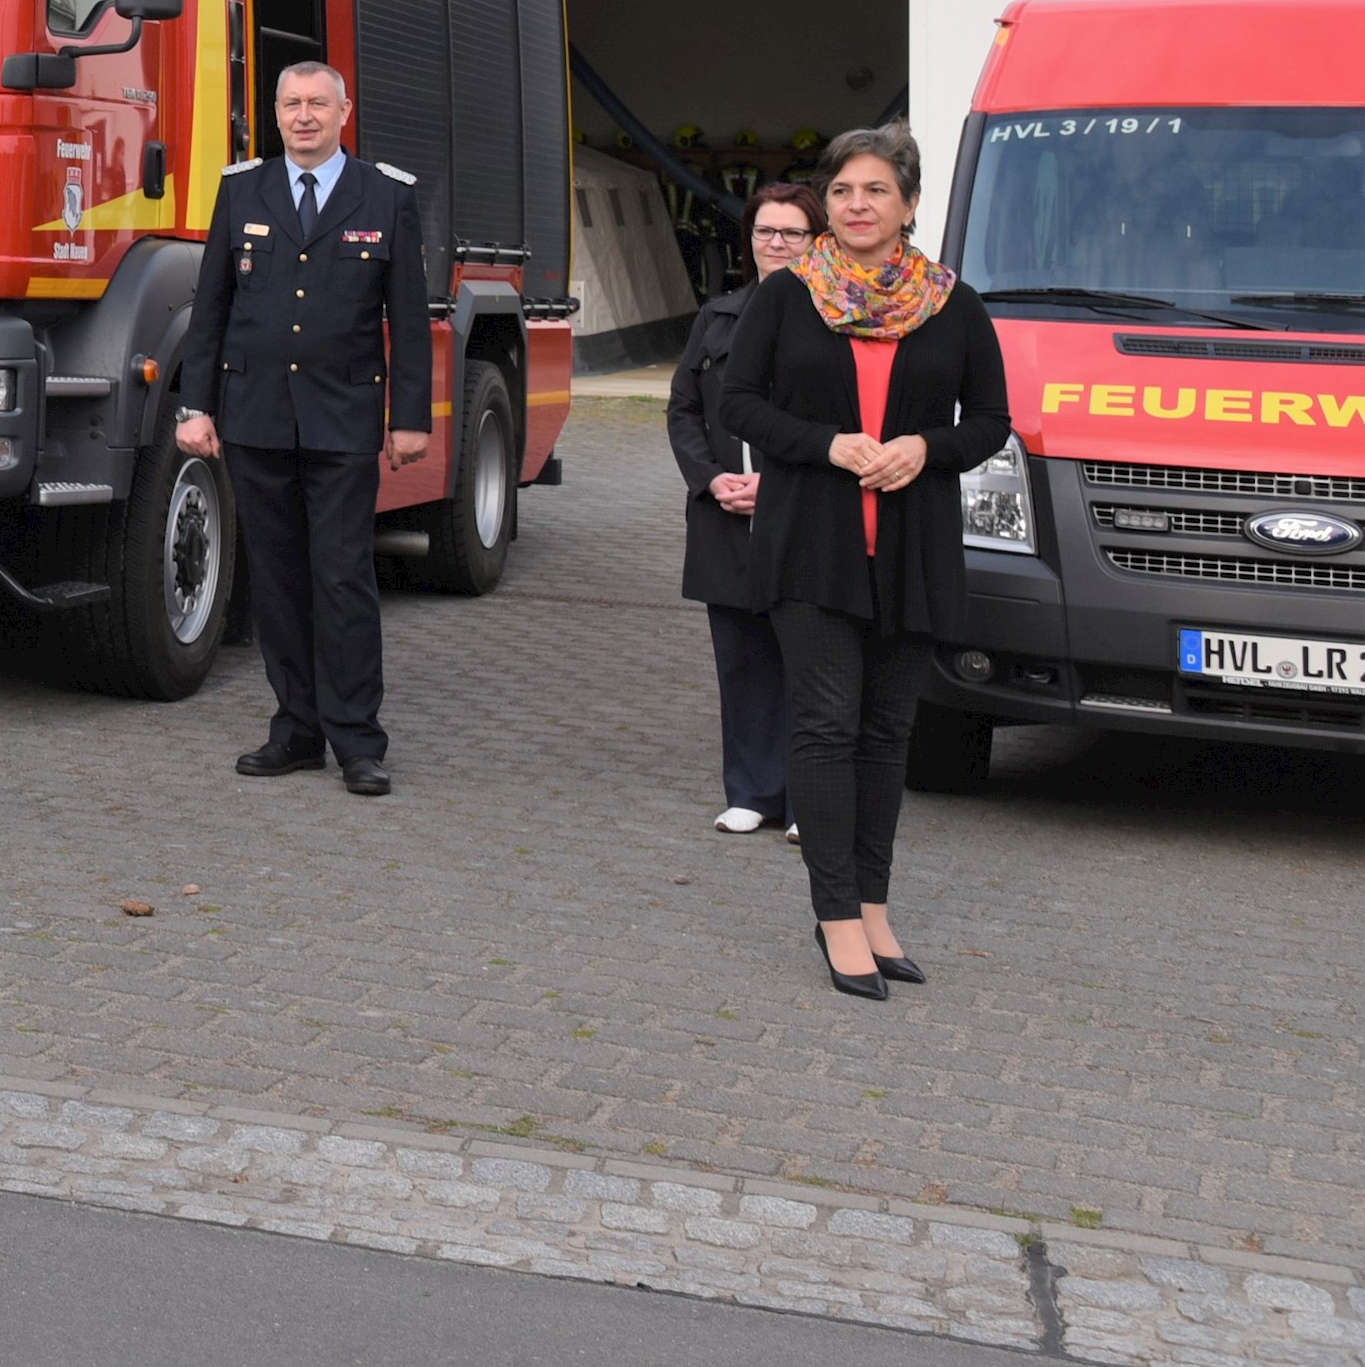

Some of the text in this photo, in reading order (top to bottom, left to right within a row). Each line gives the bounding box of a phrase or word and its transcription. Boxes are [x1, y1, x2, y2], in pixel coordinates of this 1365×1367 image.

[990, 122, 1050, 143] HVL
[1059, 120, 1076, 135] 3
[1105, 118, 1139, 133] 19
[1168, 118, 1182, 133] 1
[56, 138, 91, 160] Feuerwehr
[1272, 518, 1332, 542] Ford
[1205, 638, 1272, 674] HVL
[1302, 646, 1347, 681] LR
